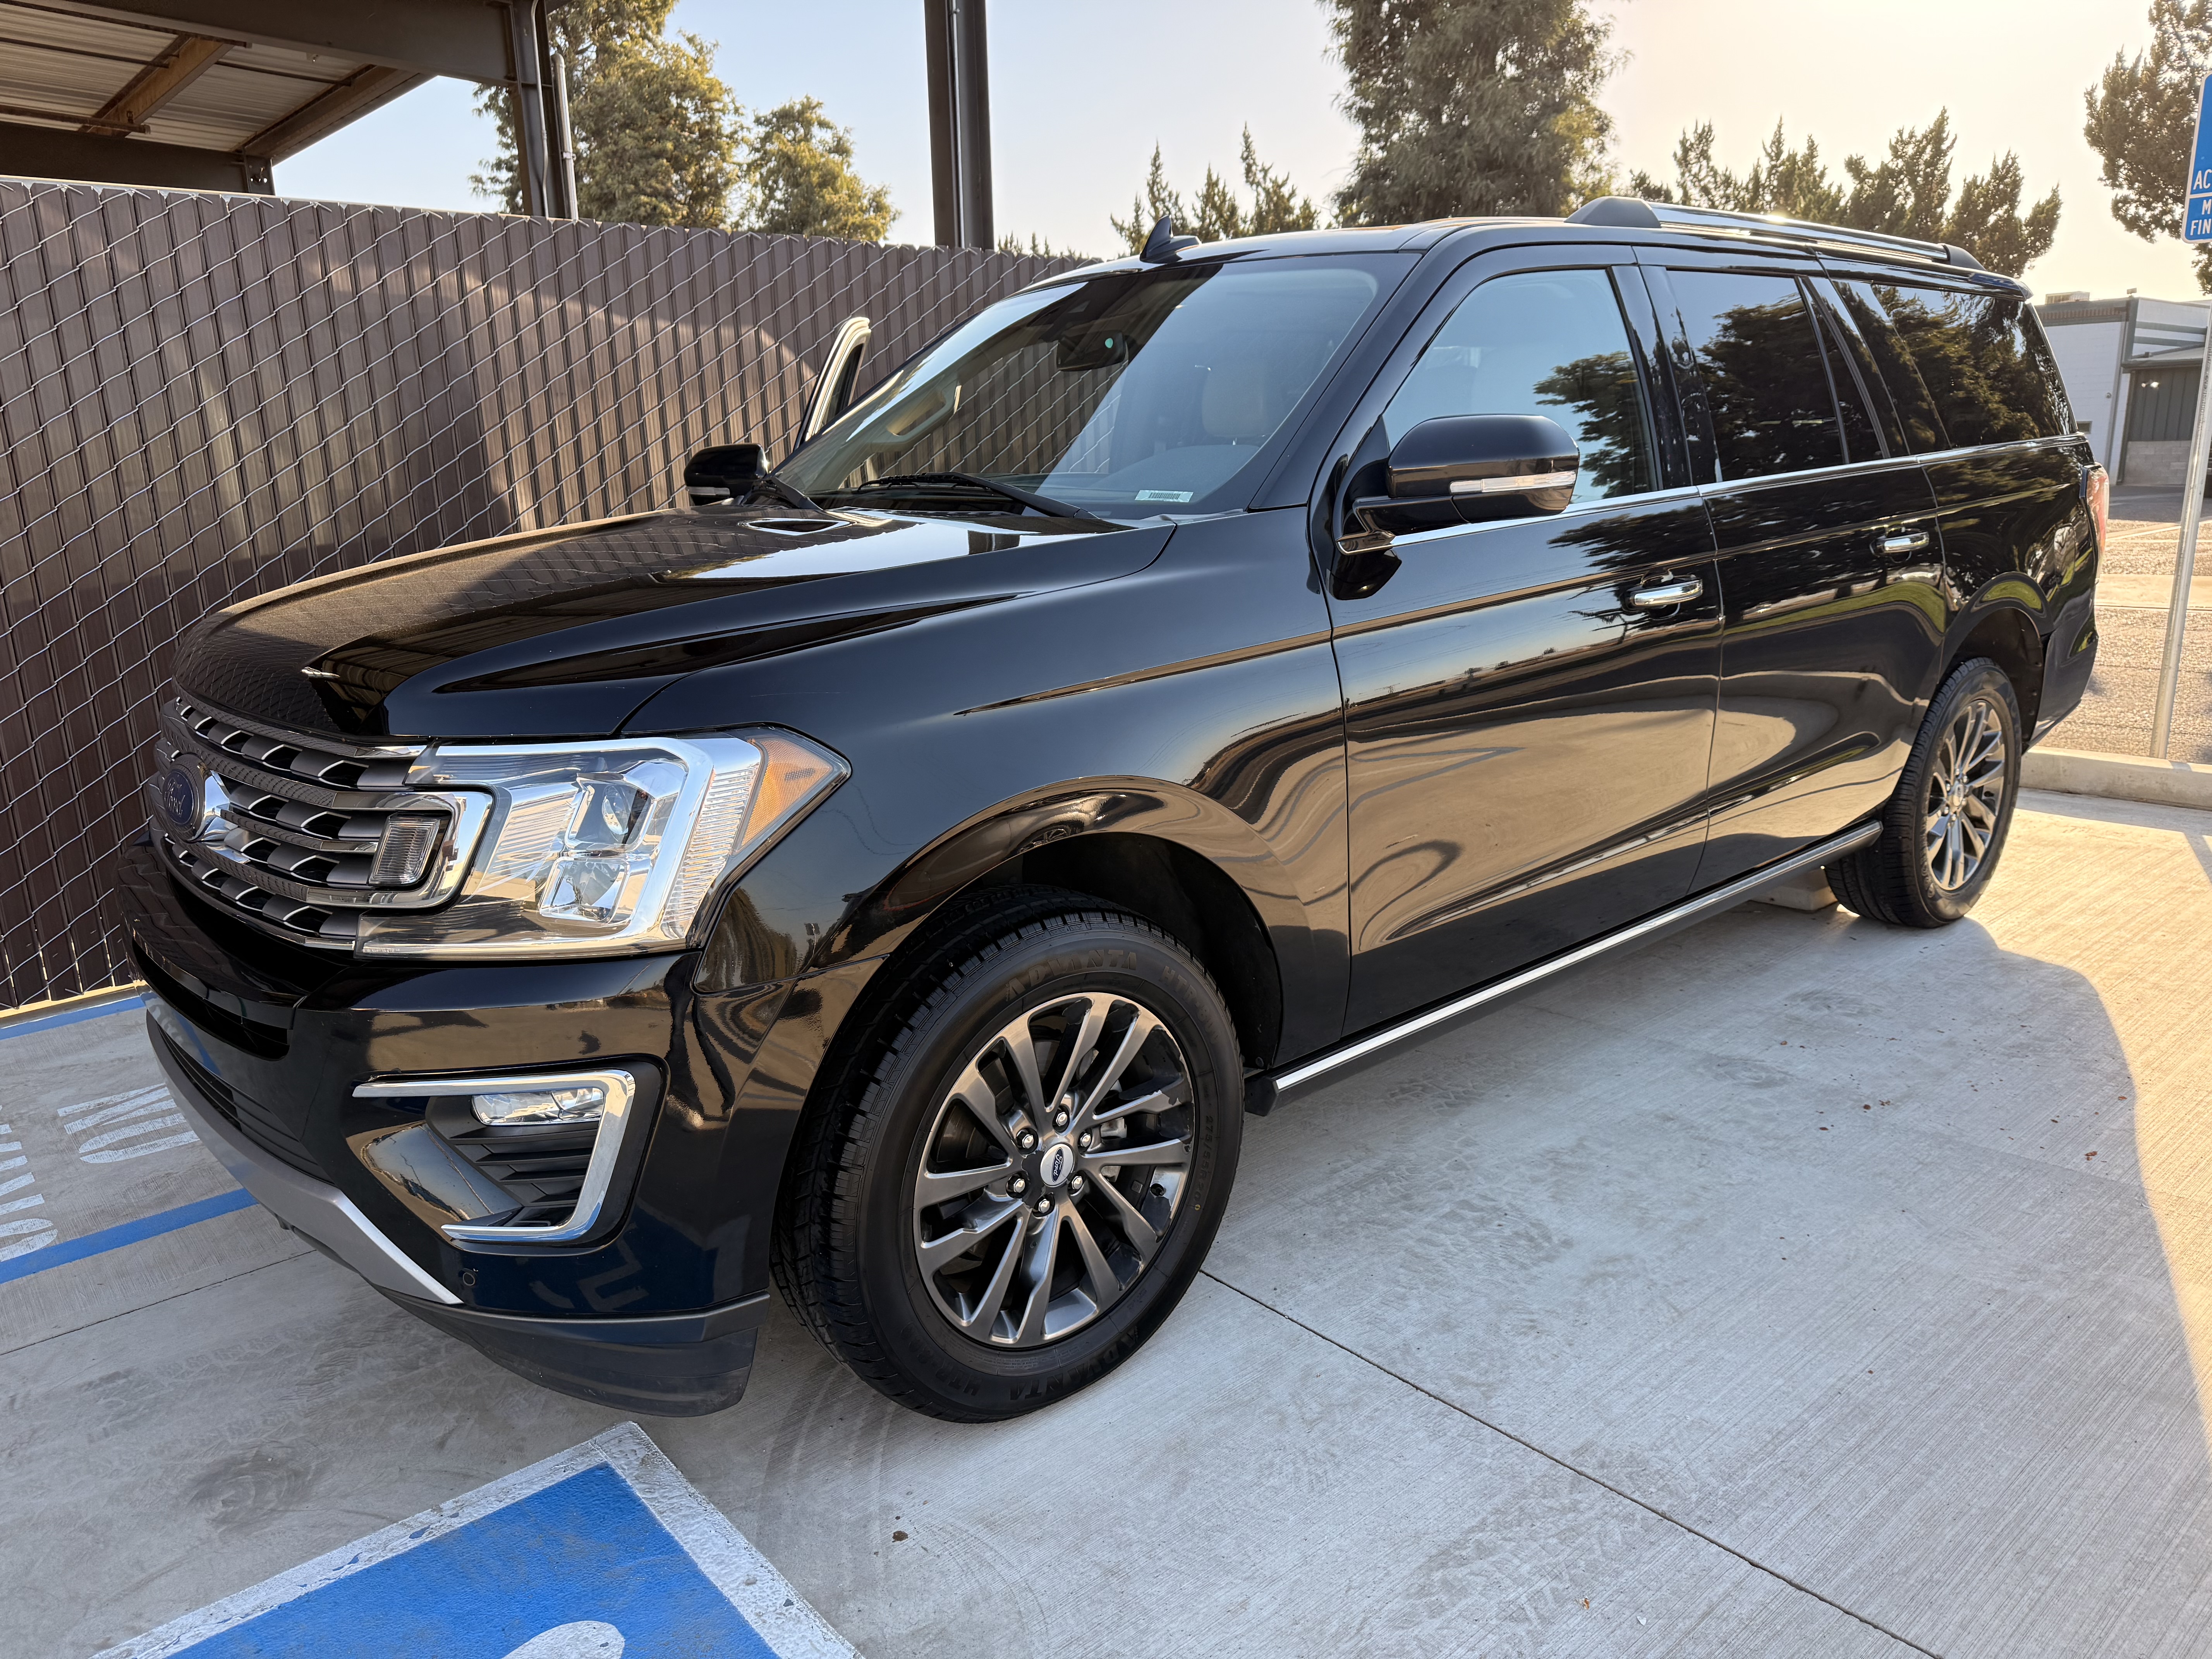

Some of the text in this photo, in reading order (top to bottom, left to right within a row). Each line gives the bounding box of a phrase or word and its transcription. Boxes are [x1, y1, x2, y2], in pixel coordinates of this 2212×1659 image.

[2190, 218, 2212, 235] FIN
[164, 777, 185, 817] Ford
[1053, 1154, 1063, 1176] Ford
